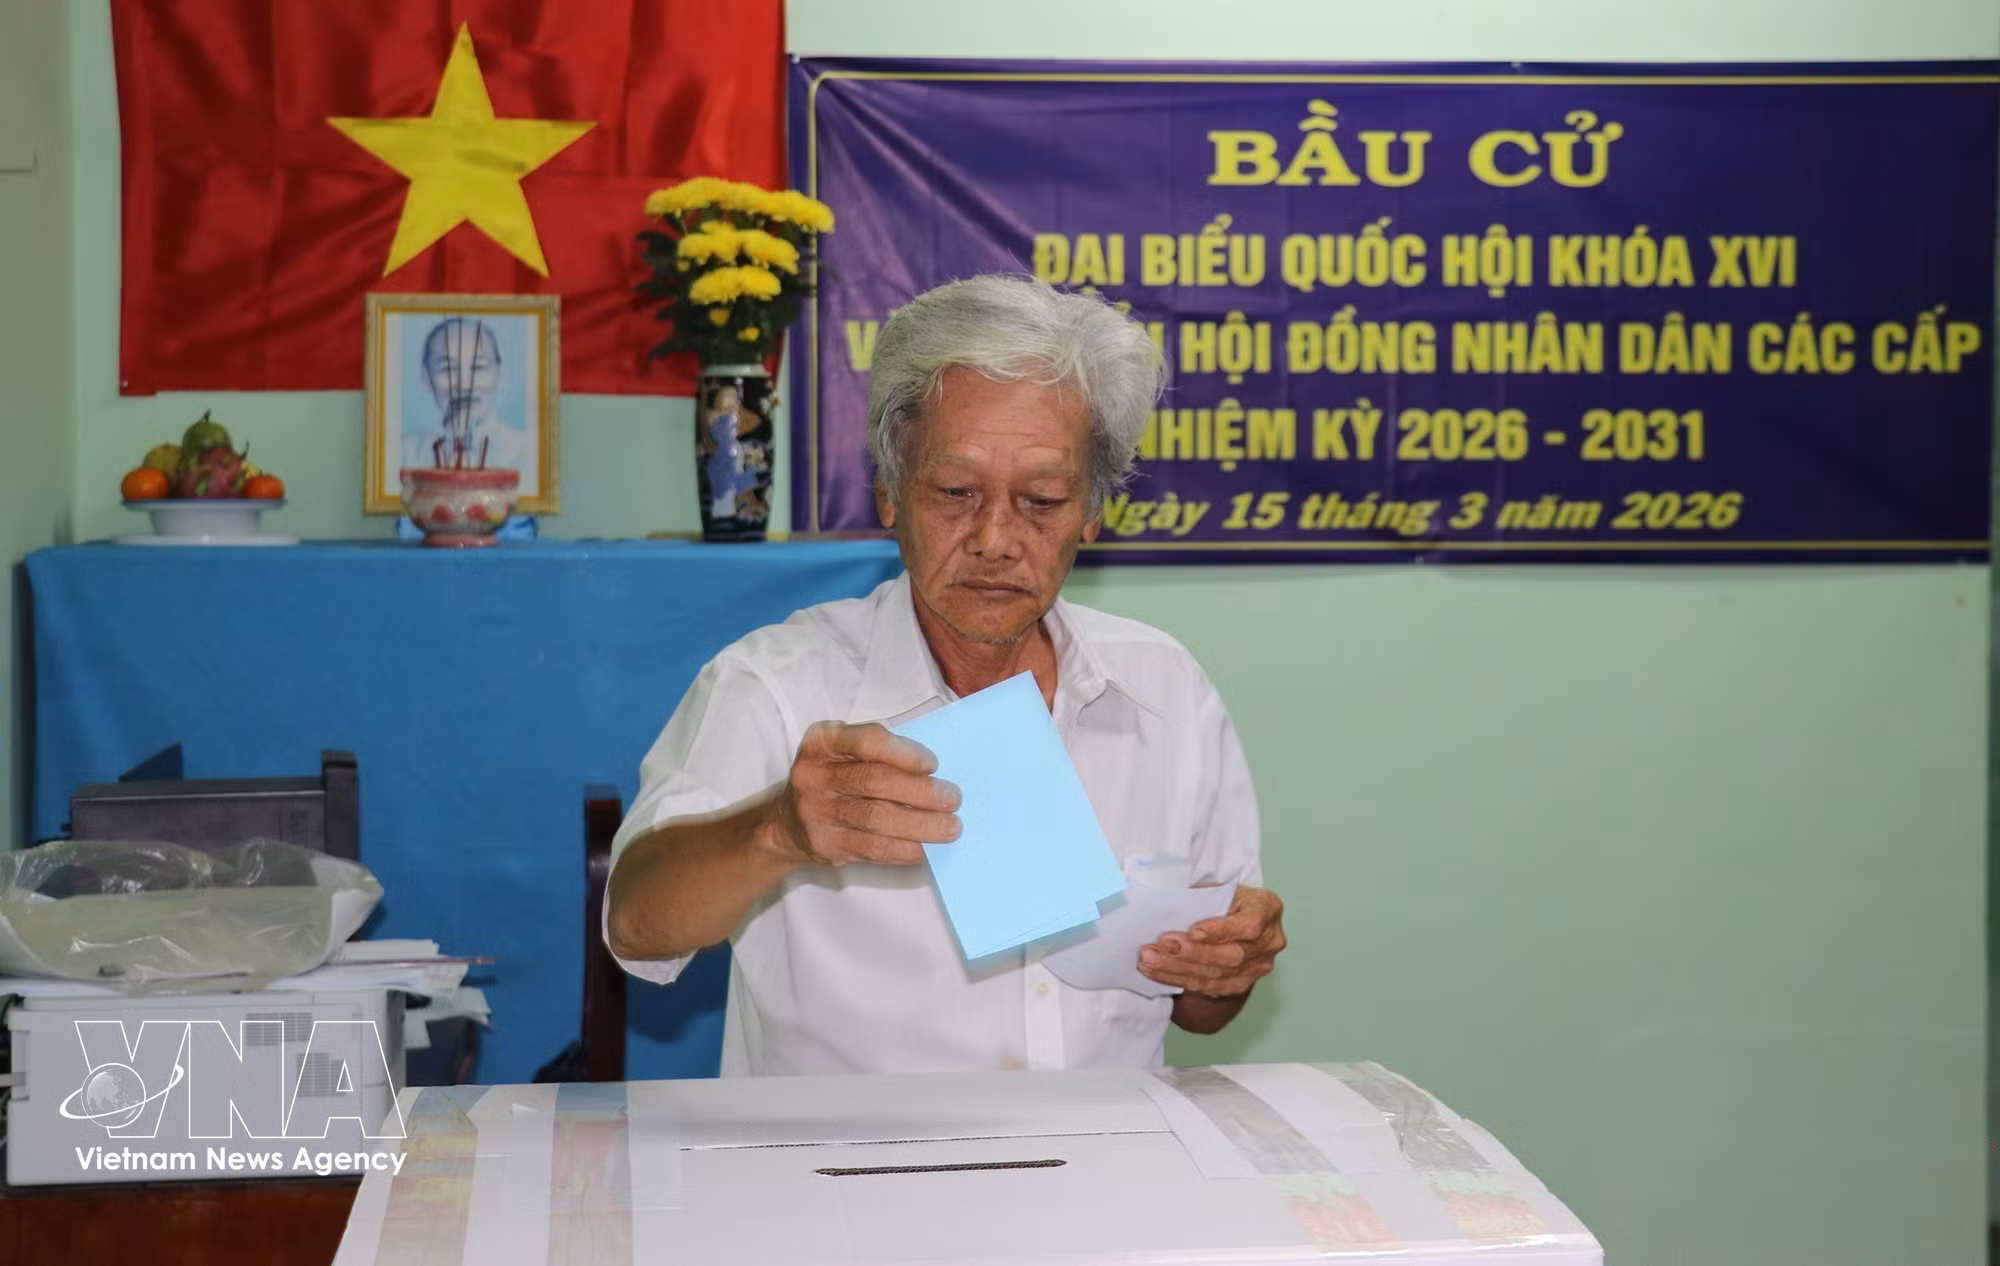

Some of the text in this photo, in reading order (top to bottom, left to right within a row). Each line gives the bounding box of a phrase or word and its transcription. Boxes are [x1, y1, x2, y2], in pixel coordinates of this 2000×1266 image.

[1207, 98, 1624, 188] BẦU CỬ
[1032, 214, 1797, 298] ĐẠI BIỂU QUỐC HỘI KHÓA XVI
[1179, 310, 1272, 384] HỘI
[1286, 303, 1437, 374] ĐỒNG
[1451, 311, 1604, 374] NHÂN
[1619, 311, 1732, 374] DÂN
[1748, 312, 1856, 374] CÁC
[1872, 304, 1983, 374] CẤP
[1313, 398, 1384, 460] KỲ
[1397, 408, 1529, 461] 2026
[1543, 431, 1567, 445] -
[1580, 408, 1704, 461] 2031
[1103, 491, 1744, 536] Ngày 15 tháng 3 năm 2026
